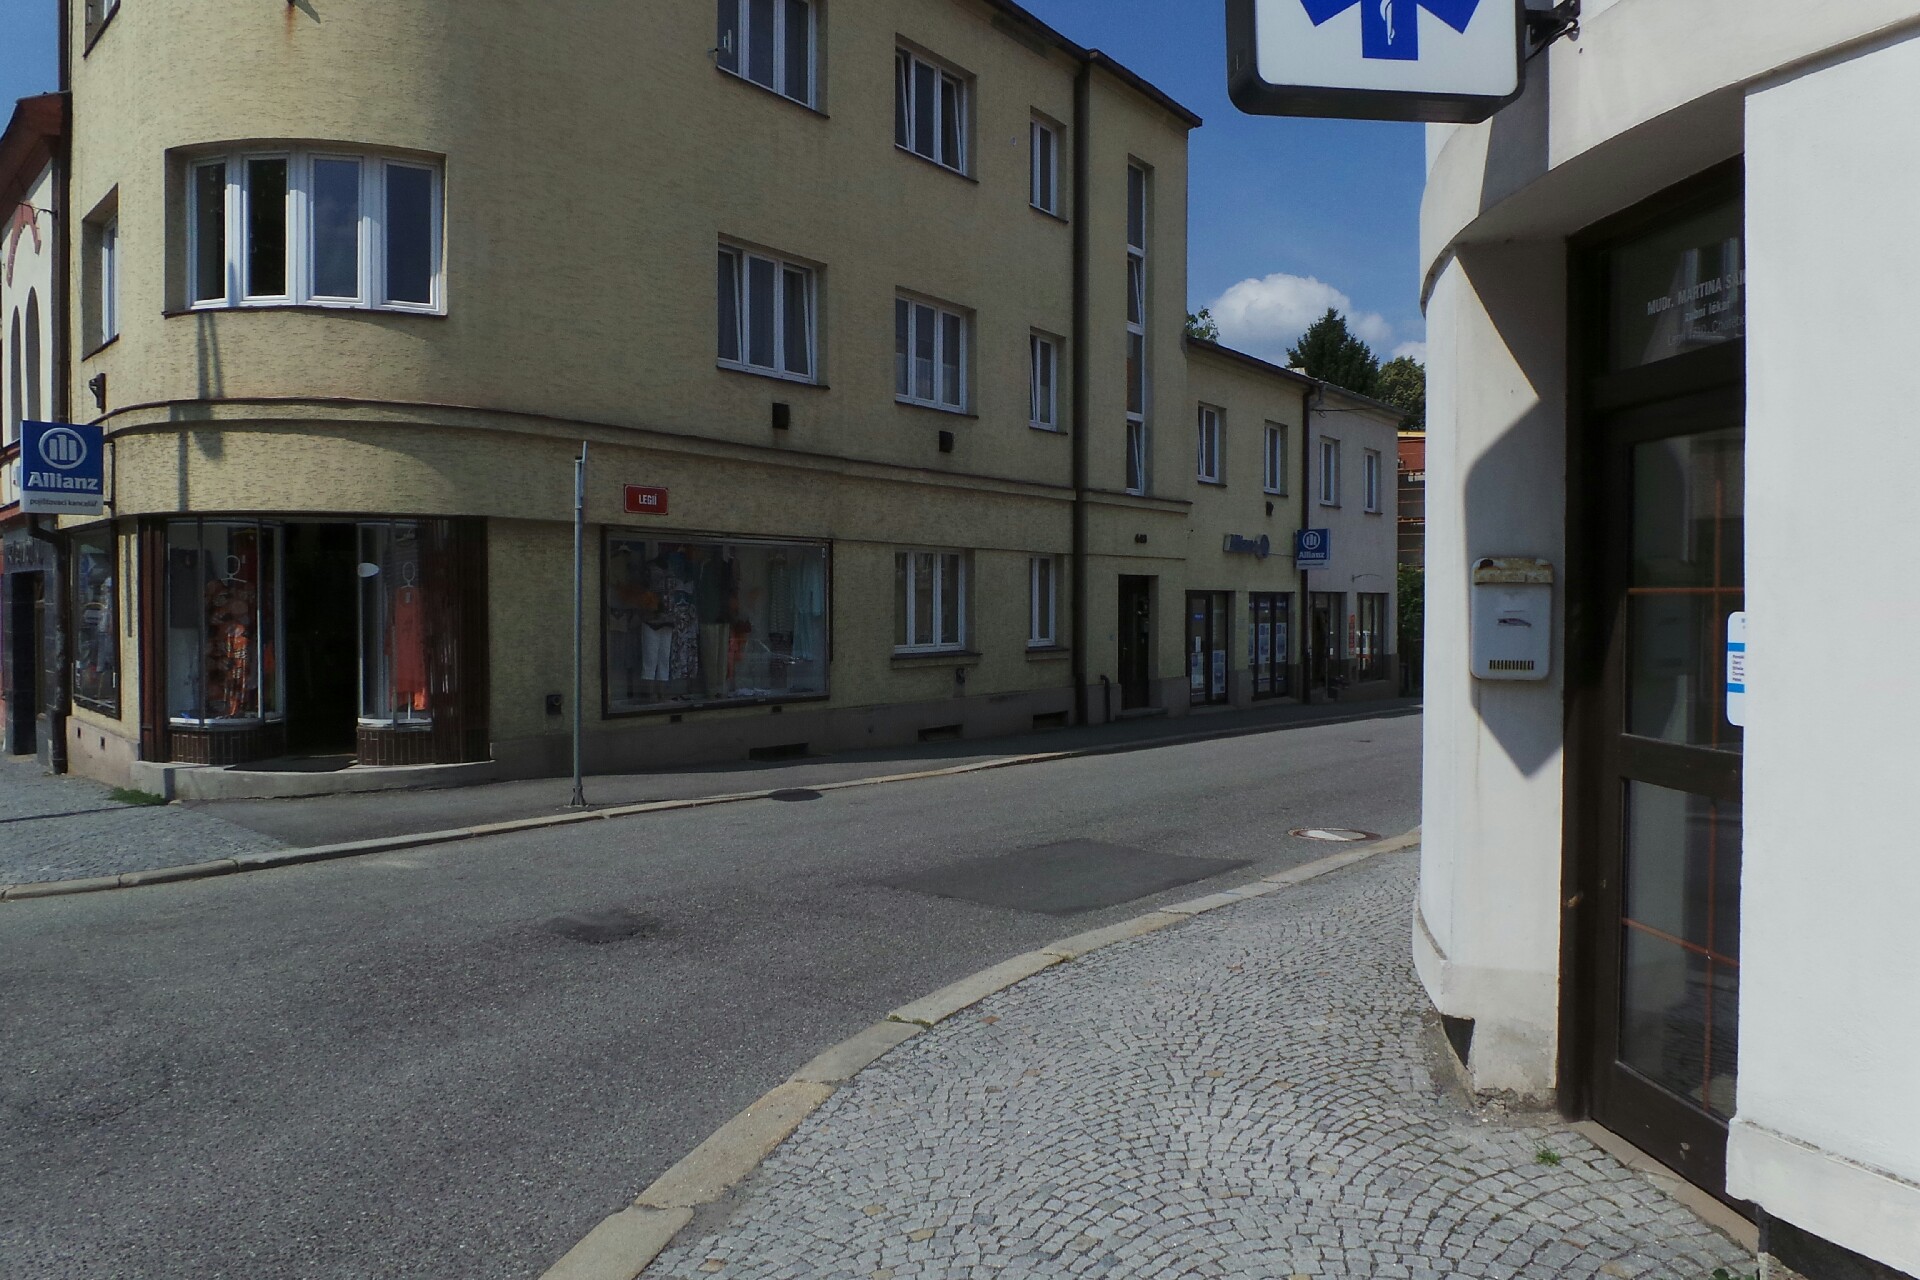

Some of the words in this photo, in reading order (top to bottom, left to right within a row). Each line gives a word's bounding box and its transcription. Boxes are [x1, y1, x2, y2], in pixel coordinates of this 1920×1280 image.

[1647, 296, 1674, 315] MUDr.
[1678, 278, 1722, 305] MARTINA
[27, 471, 98, 490] Allianz
[1298, 551, 1325, 559] Allianz
